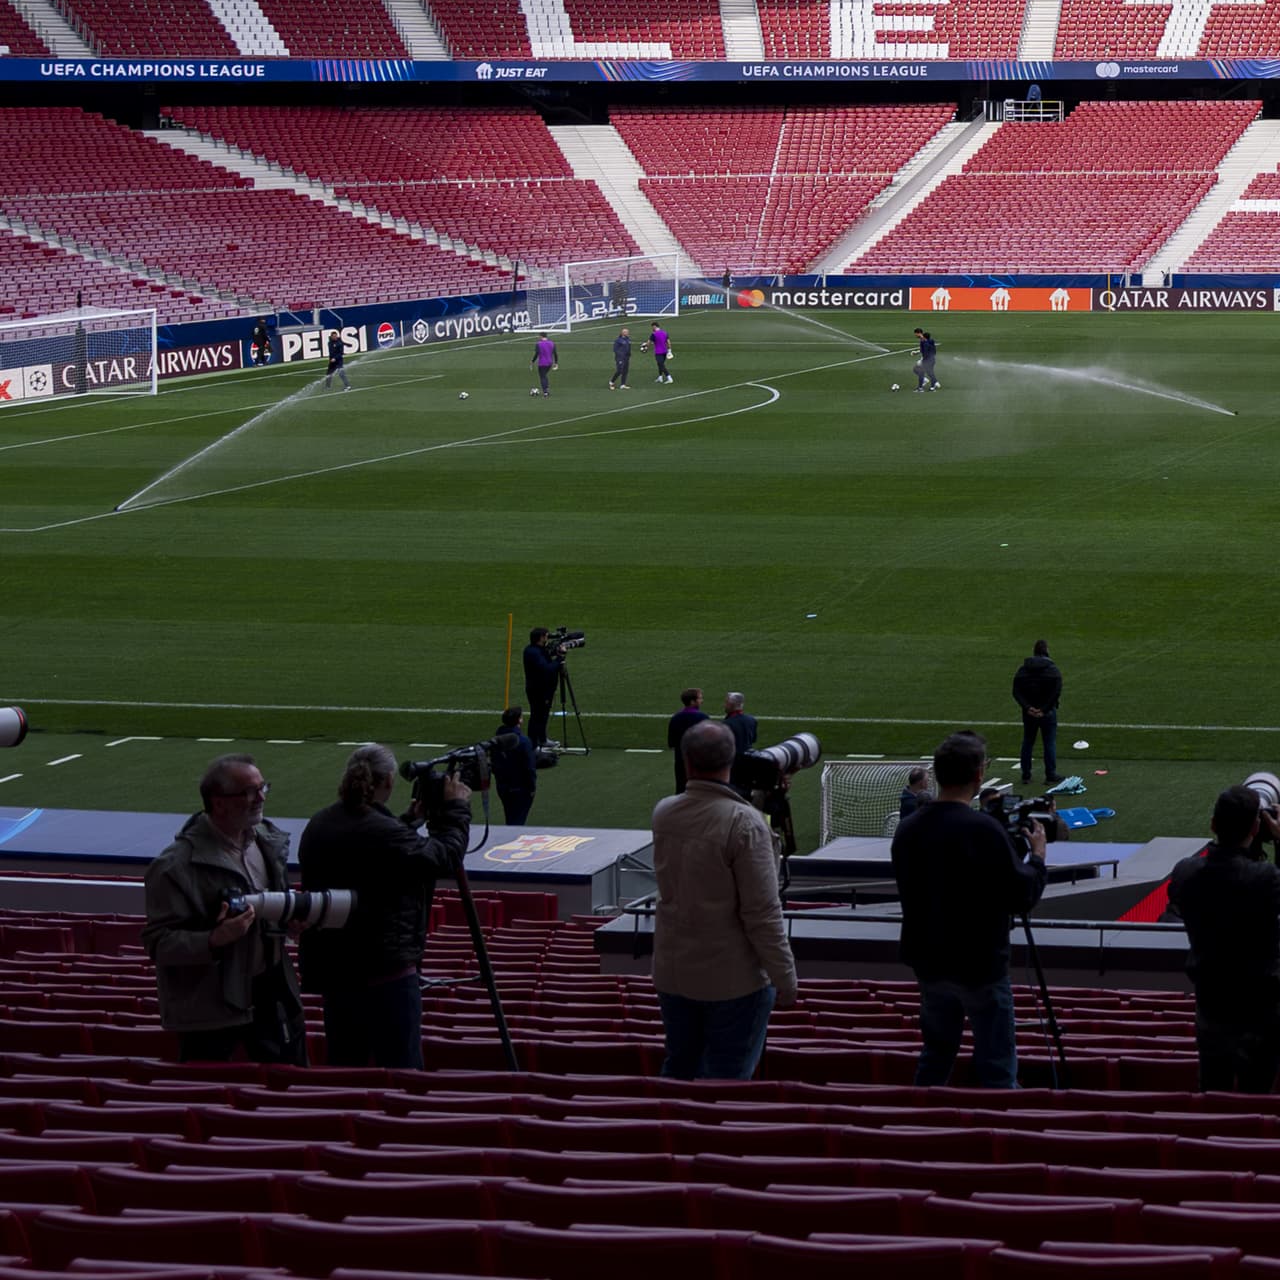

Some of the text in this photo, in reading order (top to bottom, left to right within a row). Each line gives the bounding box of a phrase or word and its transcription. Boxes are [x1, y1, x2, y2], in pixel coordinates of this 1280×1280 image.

[40, 63, 265, 78] UEFA CHAMPIONS LEAGUE
[495, 67, 547, 79] JUST EAT
[742, 65, 928, 78] UEFA CHAMPIONS LEAGUE
[1123, 64, 1179, 74] mastercard
[681, 293, 725, 306] #FOOTBALL
[771, 288, 903, 308] mastercard
[1098, 289, 1268, 310] QATAR AIRWAYS
[282, 325, 367, 363] PEPSI
